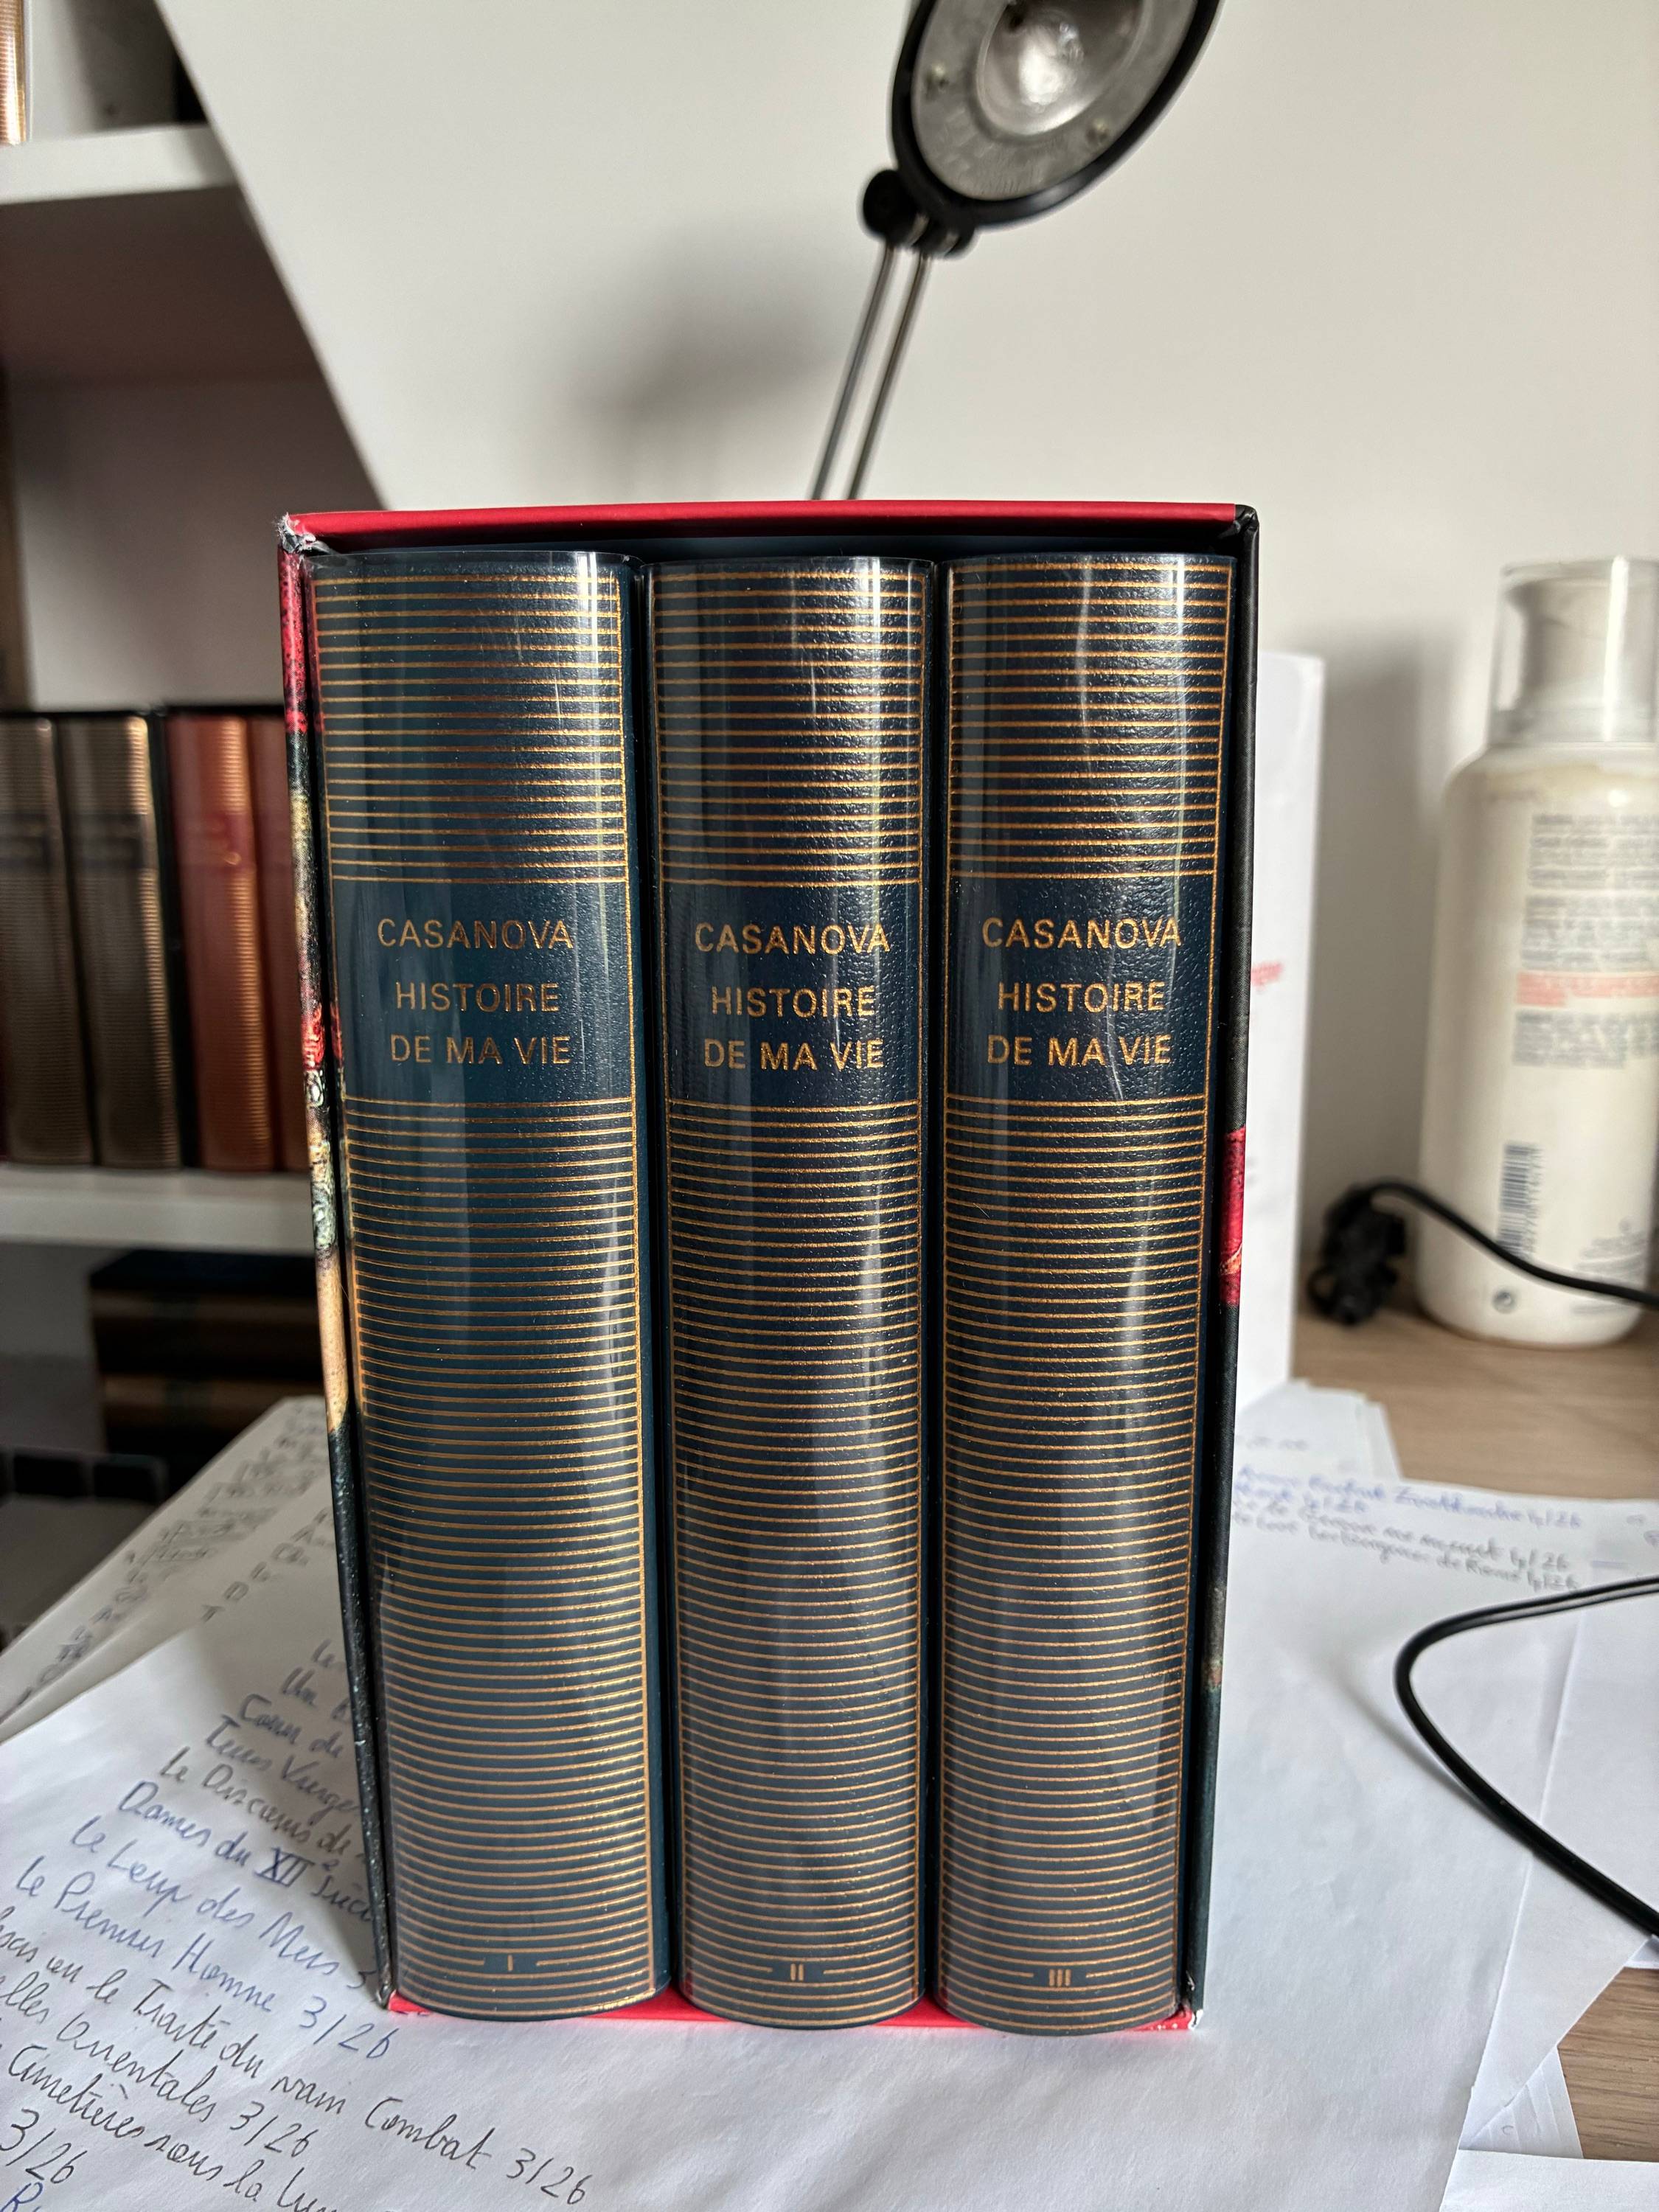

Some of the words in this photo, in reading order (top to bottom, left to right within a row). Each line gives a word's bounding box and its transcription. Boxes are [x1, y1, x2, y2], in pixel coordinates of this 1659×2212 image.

[378, 917, 574, 950] CASANOVA
[695, 922, 890, 955] CASANOVA
[981, 917, 1182, 950] CASANOVA
[395, 981, 560, 1012] HISTOIRE
[711, 985, 876, 1018] HISTOIRE
[998, 981, 1166, 1012] HISTOIRE
[391, 1034, 432, 1063] DE
[446, 1035, 503, 1065] MA
[513, 1035, 574, 1065] VIE
[703, 1038, 746, 1069] DE
[759, 1041, 818, 1071] MA
[830, 1038, 884, 1071] VIE
[987, 1034, 1032, 1066] DE
[1048, 1037, 1107, 1066] MA
[1118, 1034, 1172, 1065] VIE
[159, 1746, 190, 1782] Le
[117, 1780, 212, 1848] Dames
[214, 1831, 253, 1867] du
[71, 1815, 106, 1854] Le
[107, 1839, 192, 1918] Loup
[196, 1886, 256, 1927] des
[259, 1911, 341, 1976] Mers
[15, 1855, 46, 1897] Le
[54, 1871, 164, 1958] Premier
[172, 1933, 277, 2013] Homme
[299, 1995, 400, 2059] 3/26
[507, 1954, 514, 1972] I
[790, 1962, 805, 1982] II
[1048, 1968, 1072, 1988] III
[46, 1955, 83, 1983] ou
[86, 1969, 128, 2004] le
[133, 1978, 231, 2048] Traité
[219, 2033, 263, 2079] du
[365, 2096, 496, 2171] Combat
[506, 2147, 592, 2205] 3/26
[57, 2011, 218, 2123] Orientales
[229, 2101, 319, 2158] 3/26
[8, 2045, 145, 2138] Cimetières
[144, 2135, 223, 2181] sous
[223, 2159, 265, 2202] la
[0, 2108, 88, 2184] 3/26
